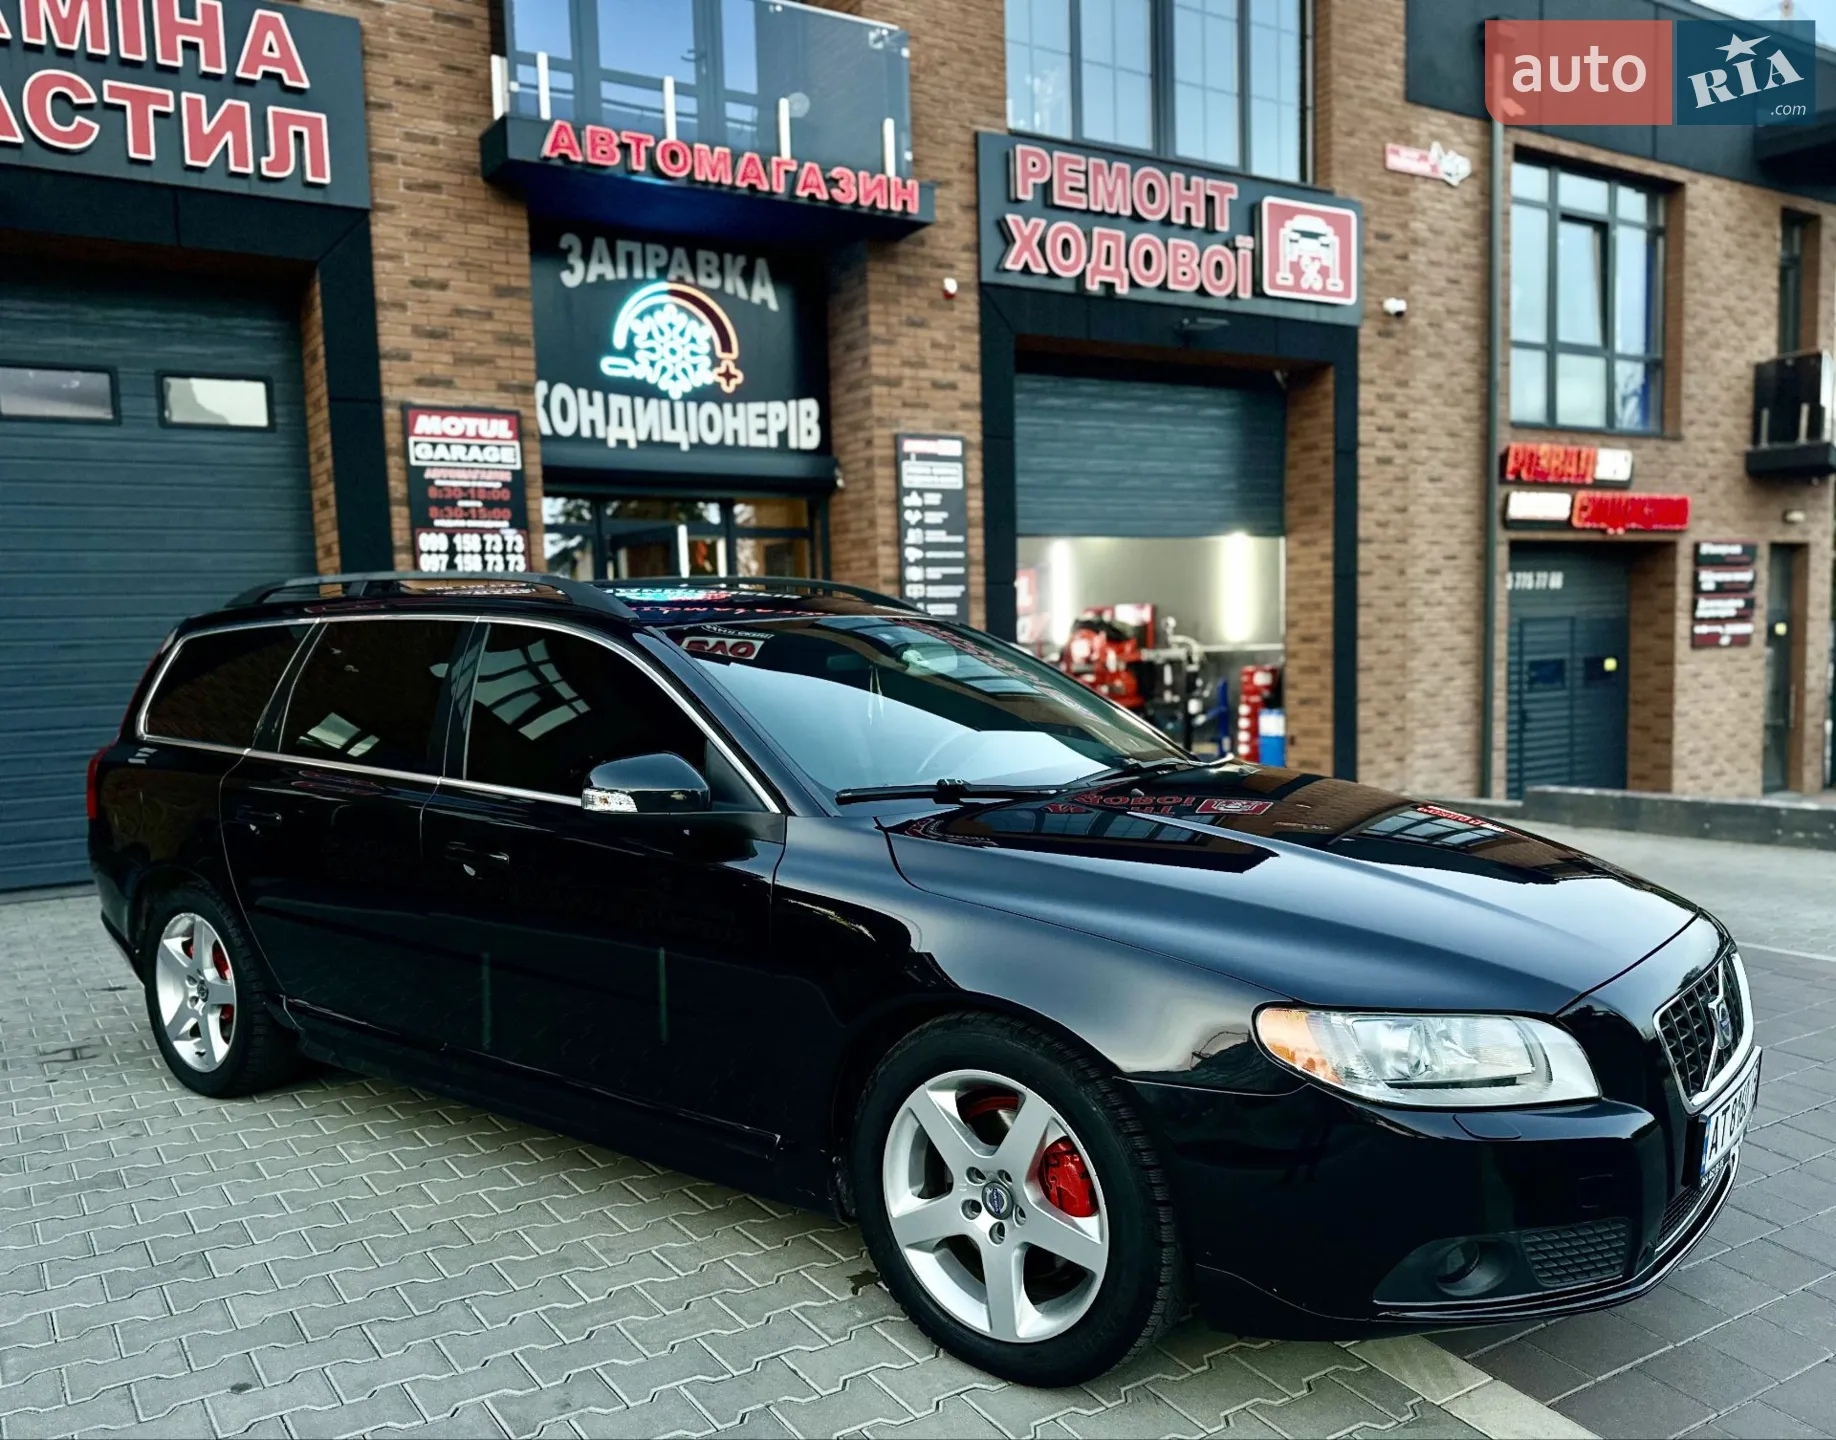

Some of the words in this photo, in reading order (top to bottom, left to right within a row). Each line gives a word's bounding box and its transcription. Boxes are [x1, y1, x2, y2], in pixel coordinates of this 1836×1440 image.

[0, 0, 311, 89] МІНА
[541, 119, 920, 215] АВТОМАГАЗИН
[1013, 143, 1239, 232] РЕМОНТ
[558, 232, 780, 312] ЗАПРАВКА
[1003, 212, 1255, 299] ХОДОВОЇ
[413, 414, 514, 439] MOTUL
[414, 442, 516, 464] GARAGE
[534, 379, 821, 451] КОНДИЦІОНЕРІВ
